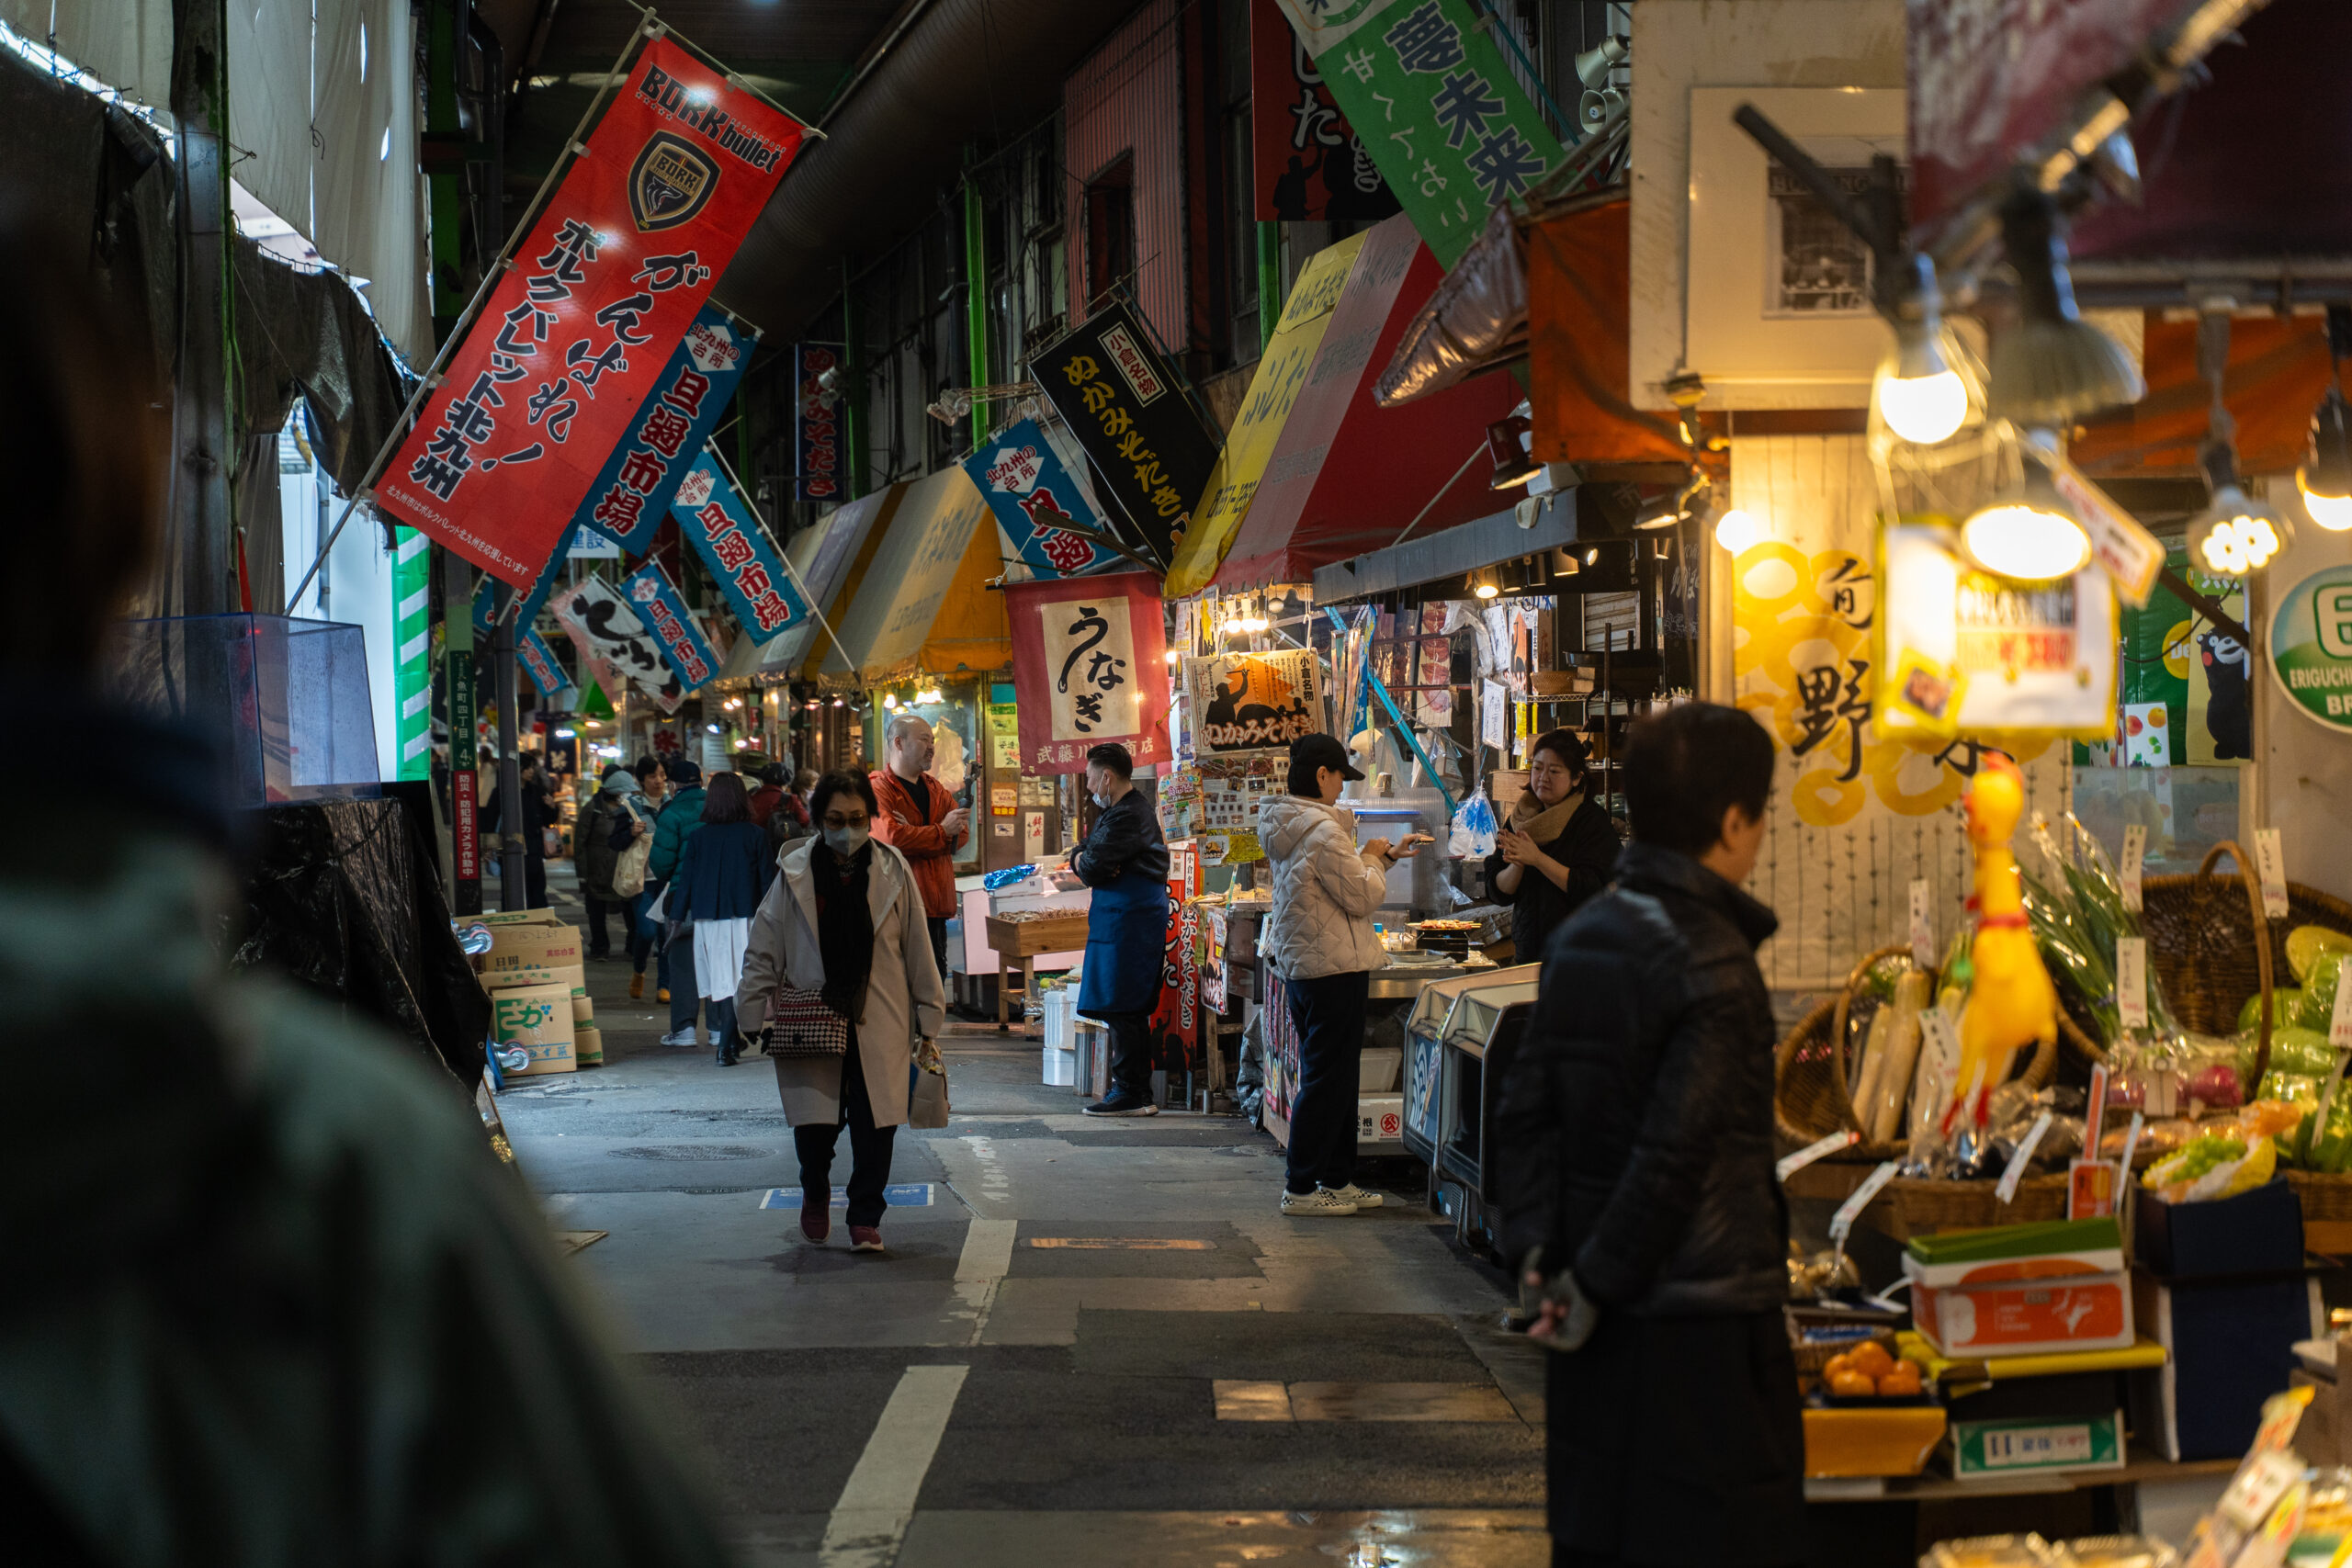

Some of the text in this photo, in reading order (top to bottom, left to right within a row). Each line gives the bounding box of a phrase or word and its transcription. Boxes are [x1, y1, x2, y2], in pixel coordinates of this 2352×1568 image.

[639, 65, 730, 141] BORK
[718, 121, 783, 175] bullet
[690, 322, 741, 362] 北九州の
[692, 341, 724, 369] 台所
[1109, 333, 1158, 396] 小倉名物
[594, 365, 710, 536] 旦過市場
[1063, 355, 1182, 518] ぬかみそだき
[986, 445, 1037, 485] 北九州の
[1003, 464, 1037, 491] 台所
[684, 484, 710, 504] 台所
[695, 501, 791, 632] 旦過市場
[646, 598, 710, 685] 旦過市場
[1057, 606, 1127, 733] うなぎ
[1300, 656, 1315, 702] 小倉名物
[1036, 737, 1155, 765] 武藤川商店
[1201, 714, 1316, 748] ぬかみそだき
[458, 774, 474, 877] 防災・防犯用カメラ作動中
